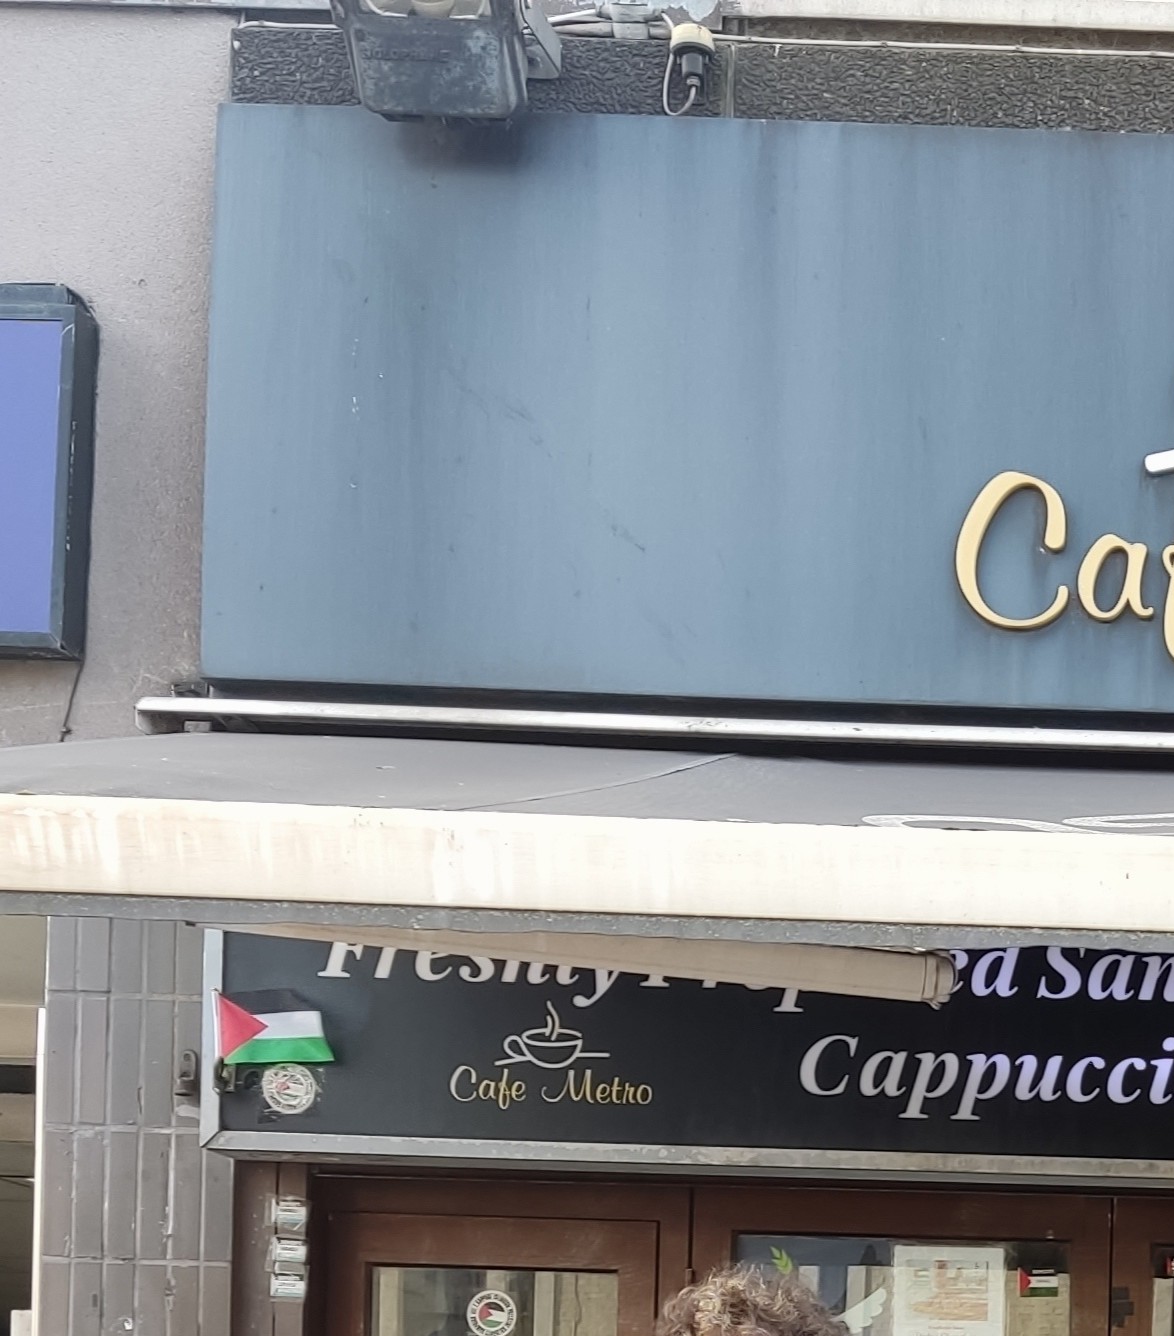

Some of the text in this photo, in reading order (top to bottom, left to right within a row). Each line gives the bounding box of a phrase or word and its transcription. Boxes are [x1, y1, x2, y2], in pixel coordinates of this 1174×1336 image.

[317, 942, 619, 1007] Fresy
[450, 1065, 653, 1110] Cafe Metro
